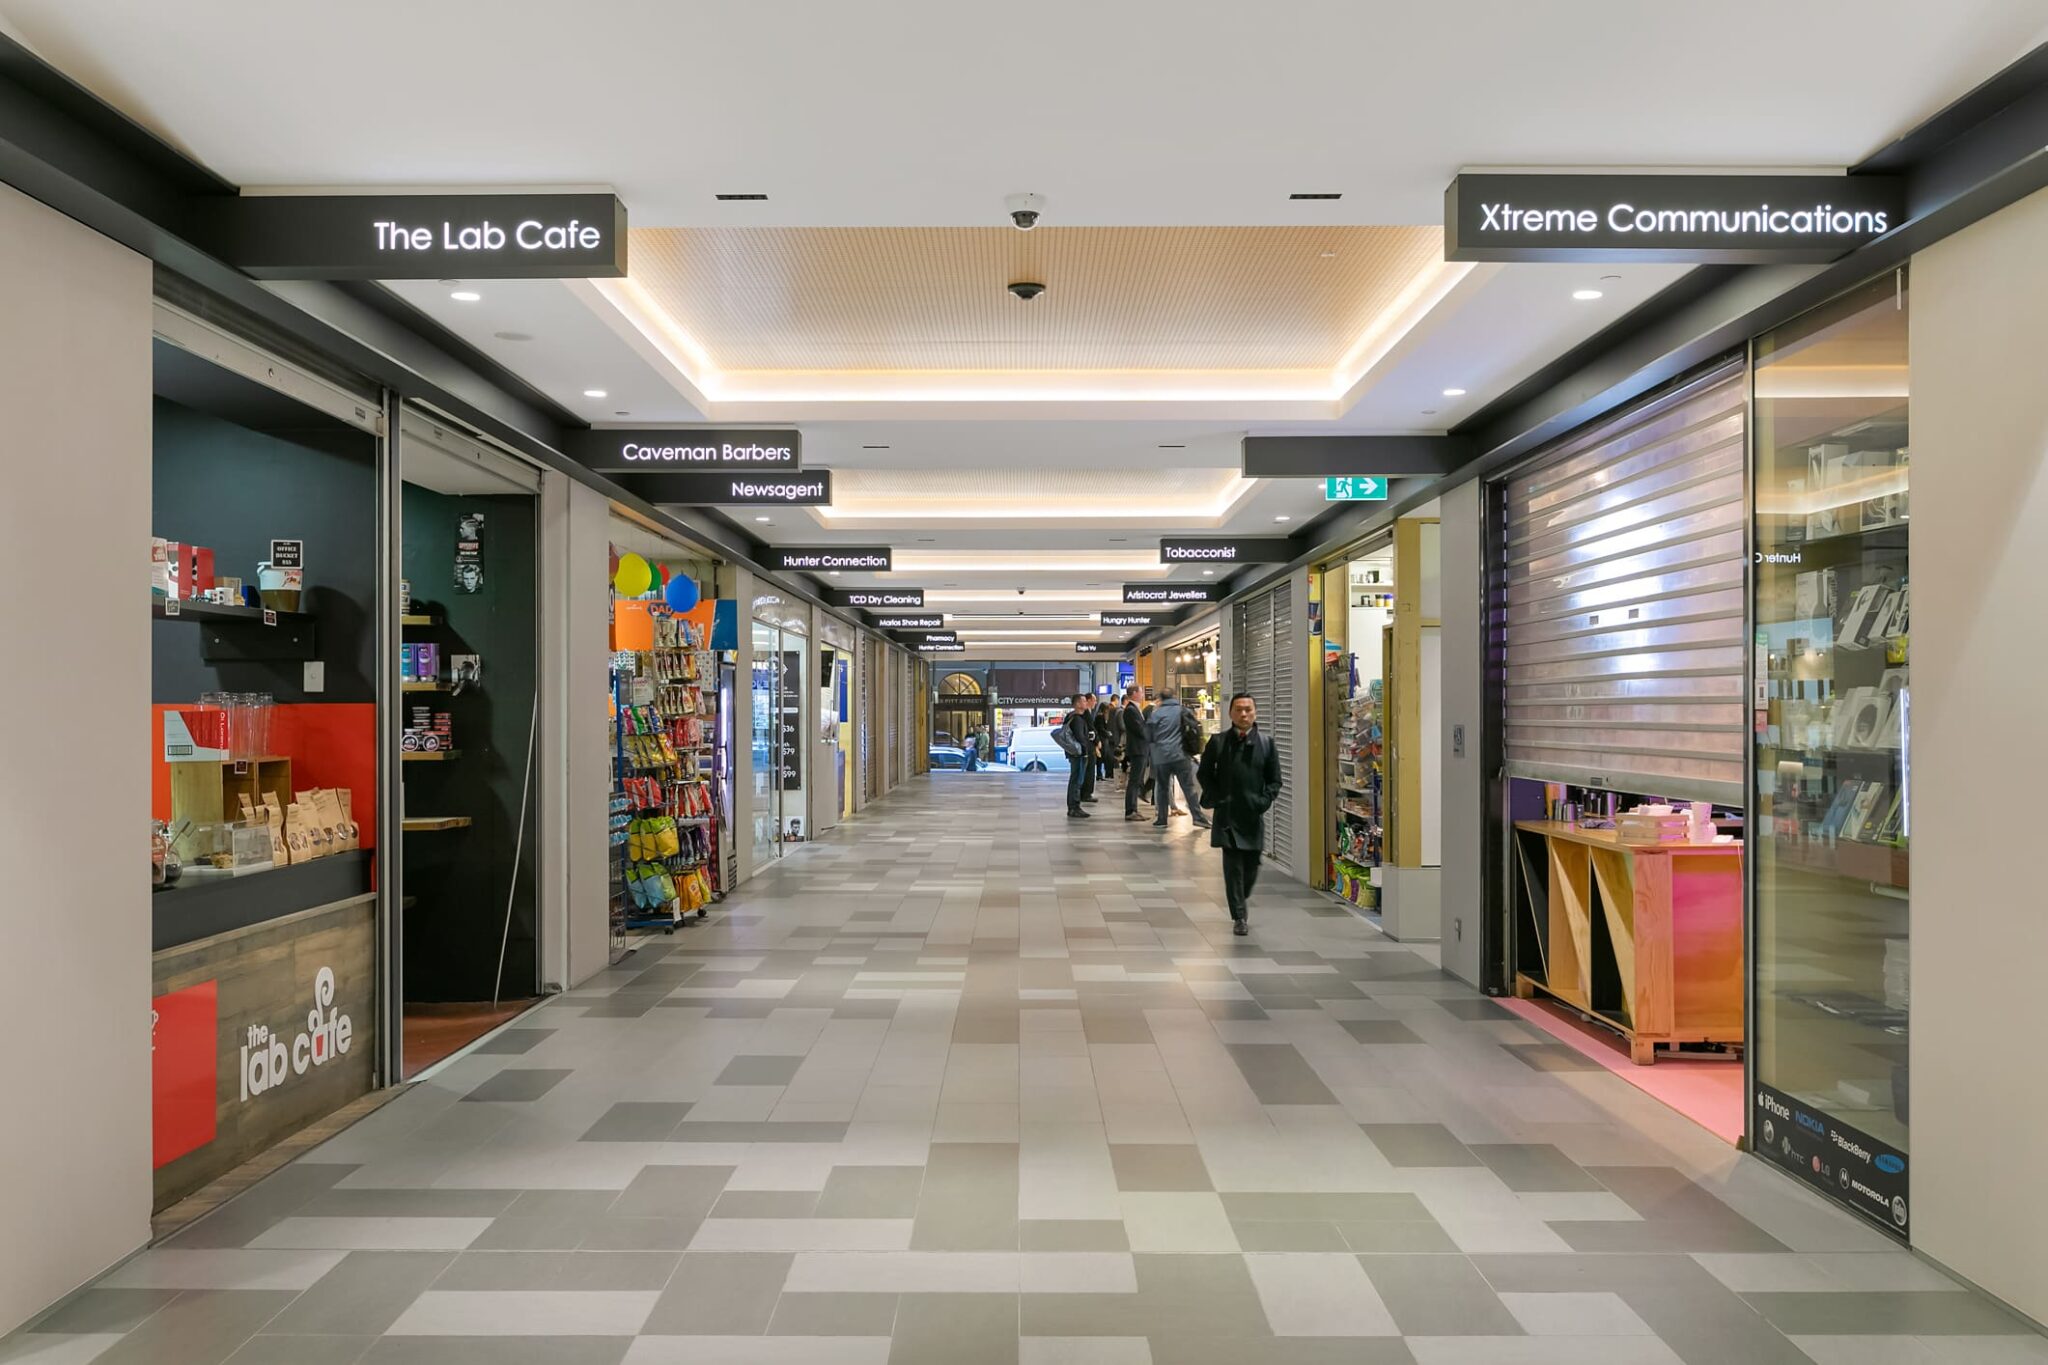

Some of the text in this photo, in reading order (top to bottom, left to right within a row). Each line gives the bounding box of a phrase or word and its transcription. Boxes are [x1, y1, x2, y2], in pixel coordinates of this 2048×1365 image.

[1480, 203, 1888, 233] Xtreme Communications
[373, 219, 601, 250] The Lab Cafe
[622, 443, 791, 461] Caveman Barbers
[731, 482, 824, 500] Newsagent
[783, 555, 887, 566] Hunter Connection
[1165, 546, 1237, 558] Tobacconist
[849, 595, 921, 606] TCD Dry Cleaning
[1126, 590, 1207, 600] Aristocrat Jewellers
[902, 619, 919, 627] Shoe
[919, 619, 941, 628] Repair
[1102, 616, 1151, 625] Hungry Hunter
[926, 635, 955, 643] Pharmacy
[998, 697, 1059, 705] CITY convenience
[247, 1023, 269, 1048] the
[240, 1006, 353, 1102] lab cafe
[1764, 1093, 1790, 1121] iPhone
[1795, 1110, 1825, 1136] NOKIA
[1837, 1136, 1871, 1165] BlackBerry
[1821, 1161, 1831, 1177] LG
[1851, 1179, 1890, 1208] MOTOROLA
